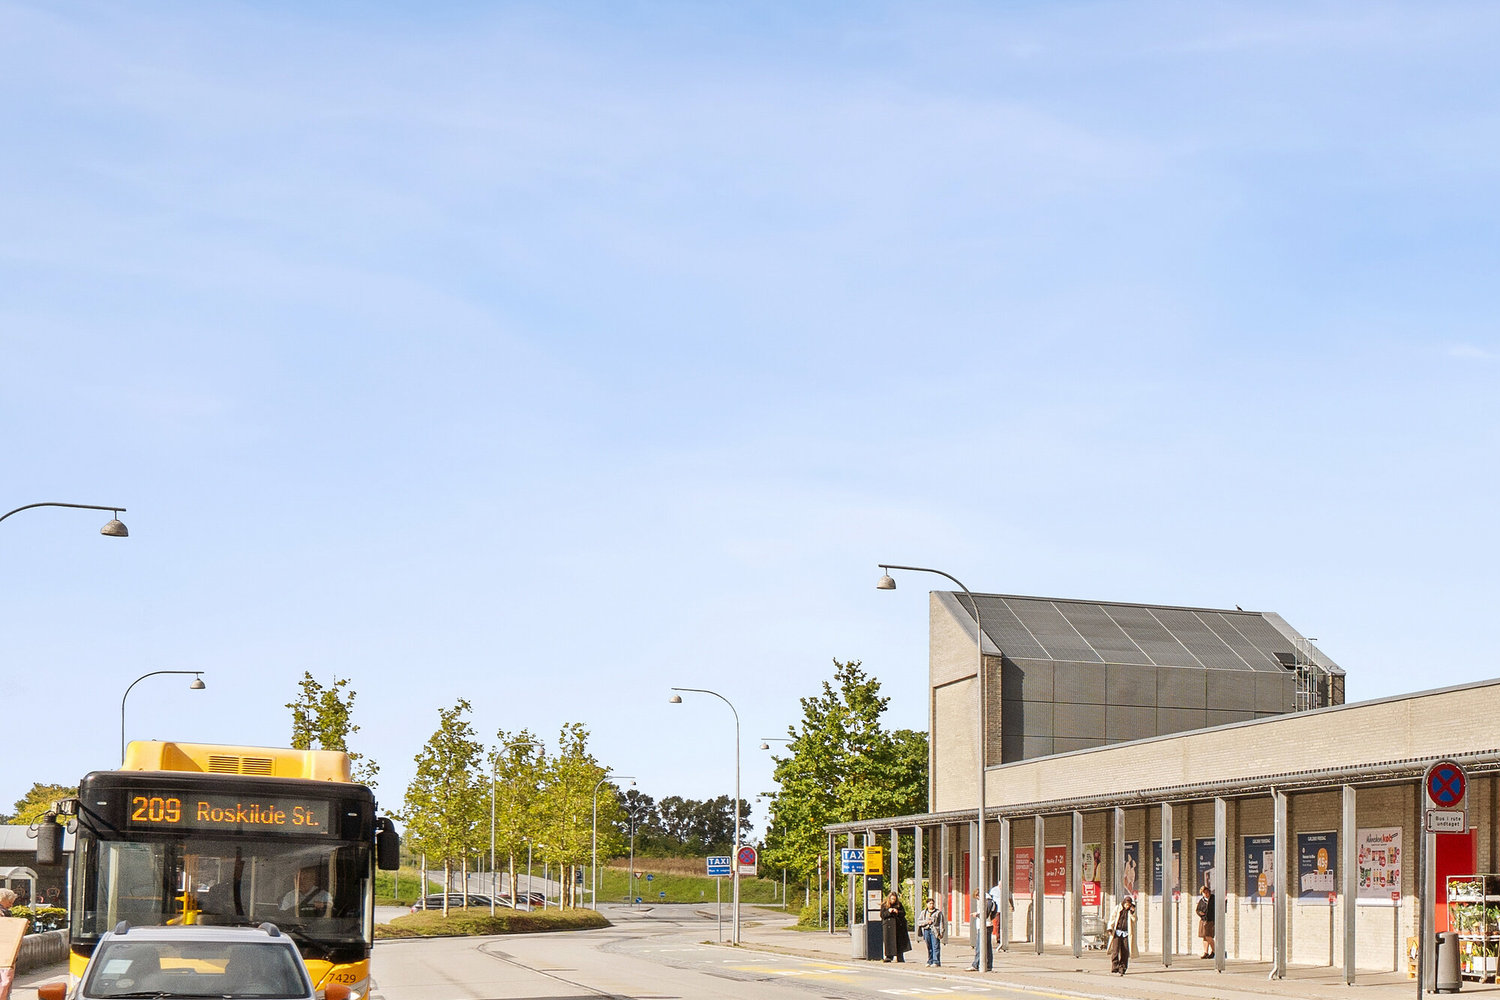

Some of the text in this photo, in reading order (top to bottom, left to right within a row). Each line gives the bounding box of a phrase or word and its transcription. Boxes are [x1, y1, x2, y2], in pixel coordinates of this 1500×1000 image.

[132, 796, 319, 826] 209 Roskilde St.
[843, 850, 865, 860] TAX
[328, 973, 357, 984] 7429
[877, 985, 992, 995] BUS
